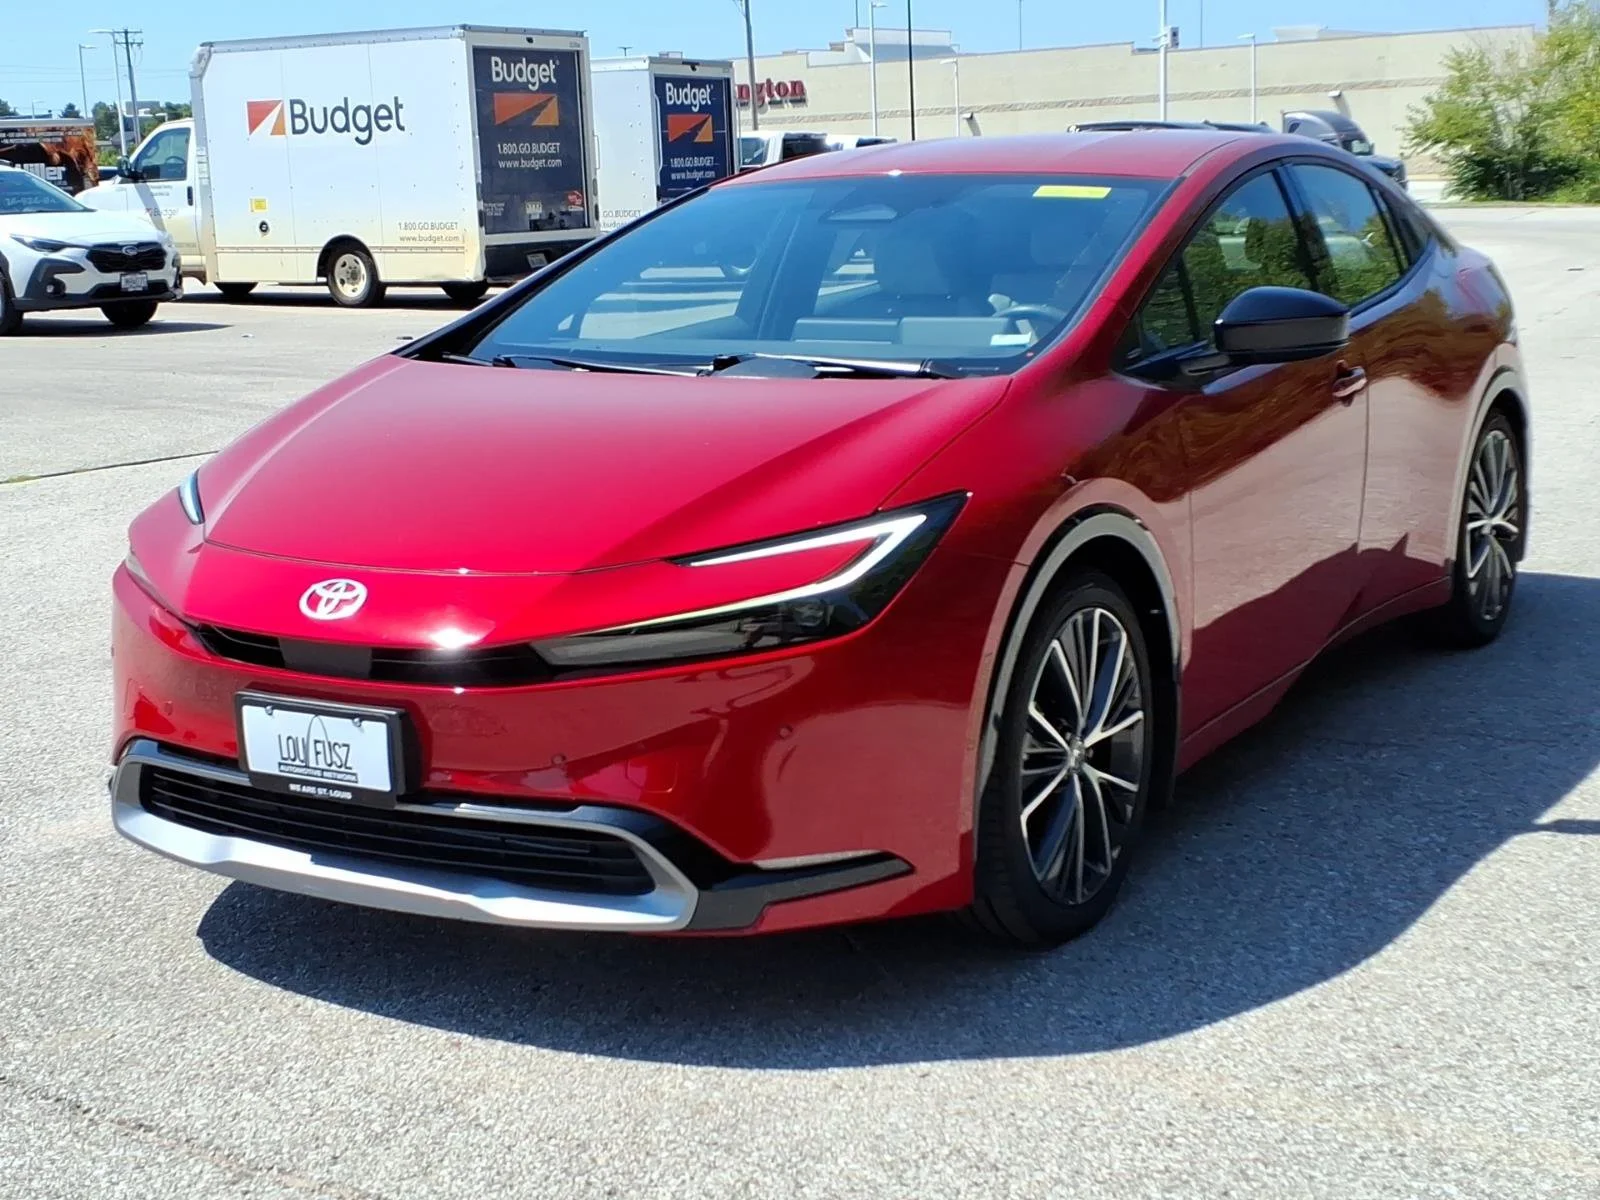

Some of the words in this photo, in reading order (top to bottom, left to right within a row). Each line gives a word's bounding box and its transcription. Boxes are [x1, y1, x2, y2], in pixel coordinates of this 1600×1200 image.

[491, 56, 557, 91] Budget
[666, 82, 712, 112] Budget
[289, 96, 405, 145] Budget
[497, 142, 560, 154] 1.800.GO.BUDGET
[498, 157, 562, 170] www.budget.com
[398, 221, 458, 231] 1.800.GO.BUDGET
[399, 234, 459, 244] www.budget.com
[278, 734, 307, 763] LOU
[313, 739, 352, 770] FUSZ
[302, 786, 316, 795] ARE
